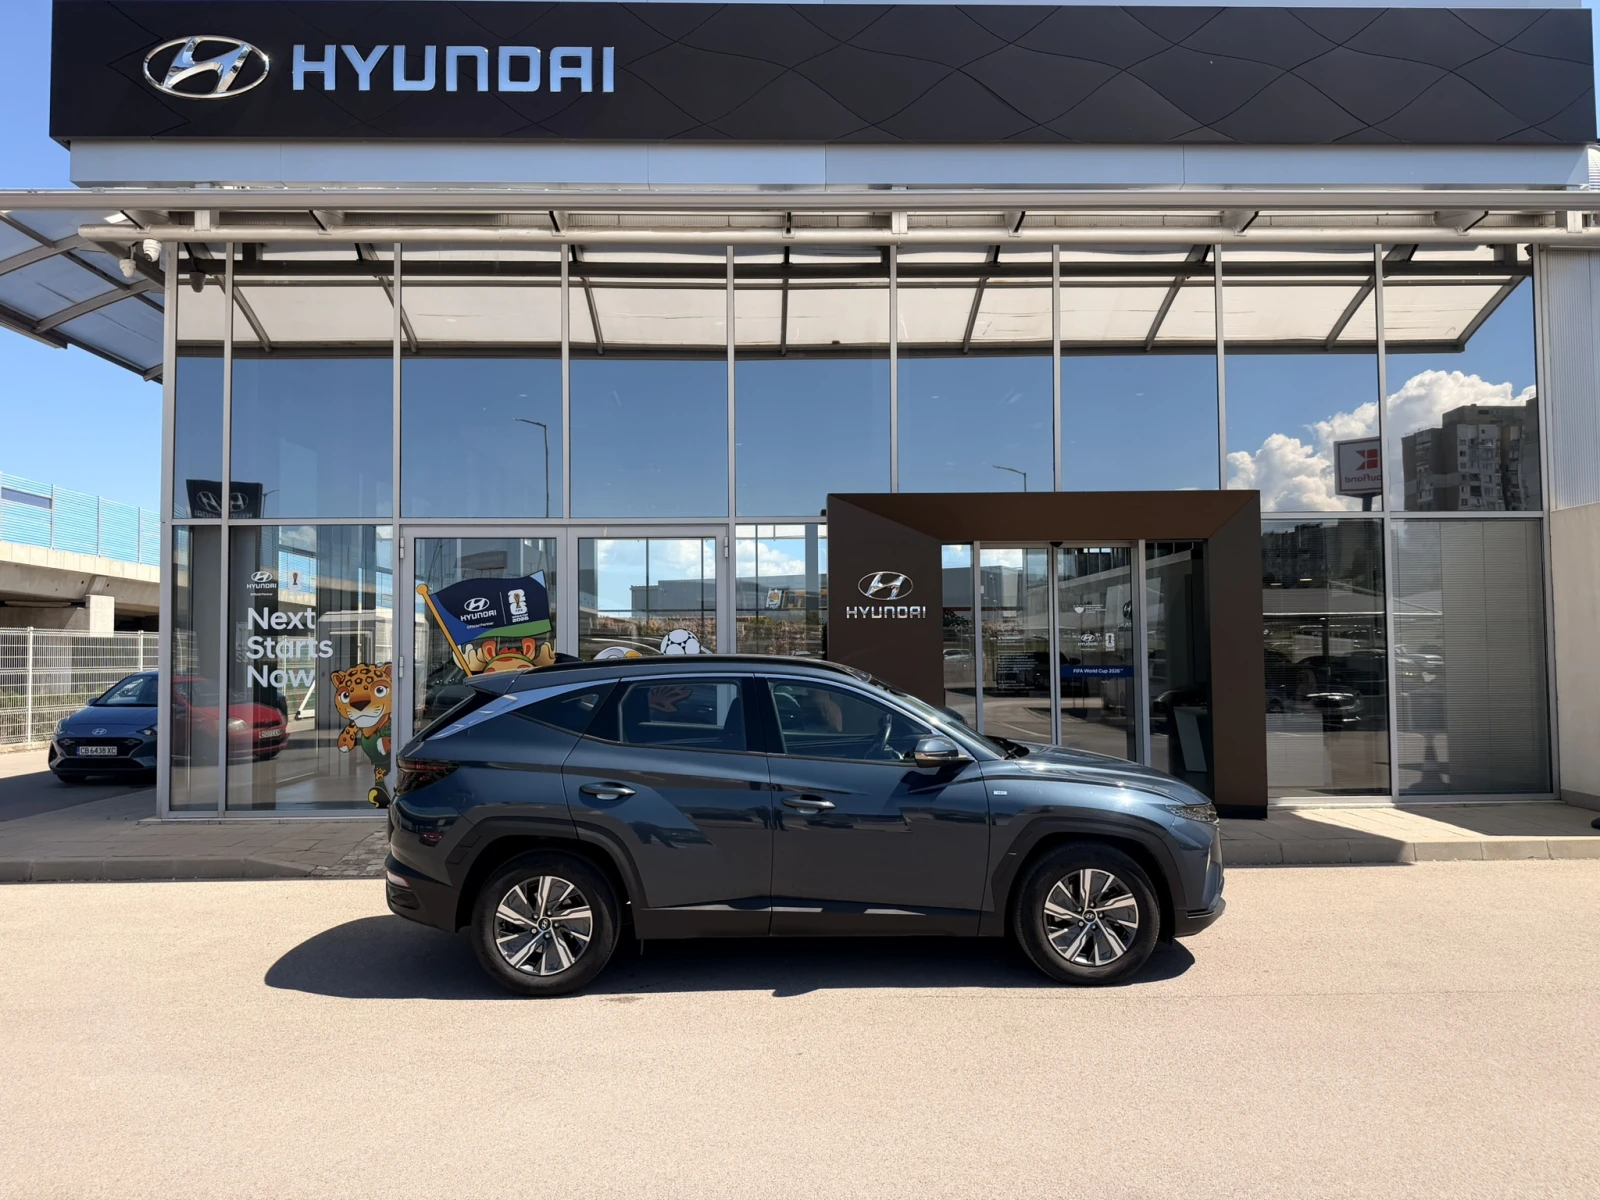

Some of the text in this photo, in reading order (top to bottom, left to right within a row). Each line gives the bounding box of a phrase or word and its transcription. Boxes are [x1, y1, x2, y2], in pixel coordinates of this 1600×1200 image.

[292, 44, 616, 93] HYUNDAI
[247, 607, 317, 630] Next
[460, 610, 497, 621] HYUNDAI
[846, 606, 927, 619] HYUNDAI
[246, 636, 334, 660] Starts
[247, 665, 316, 688] Now
